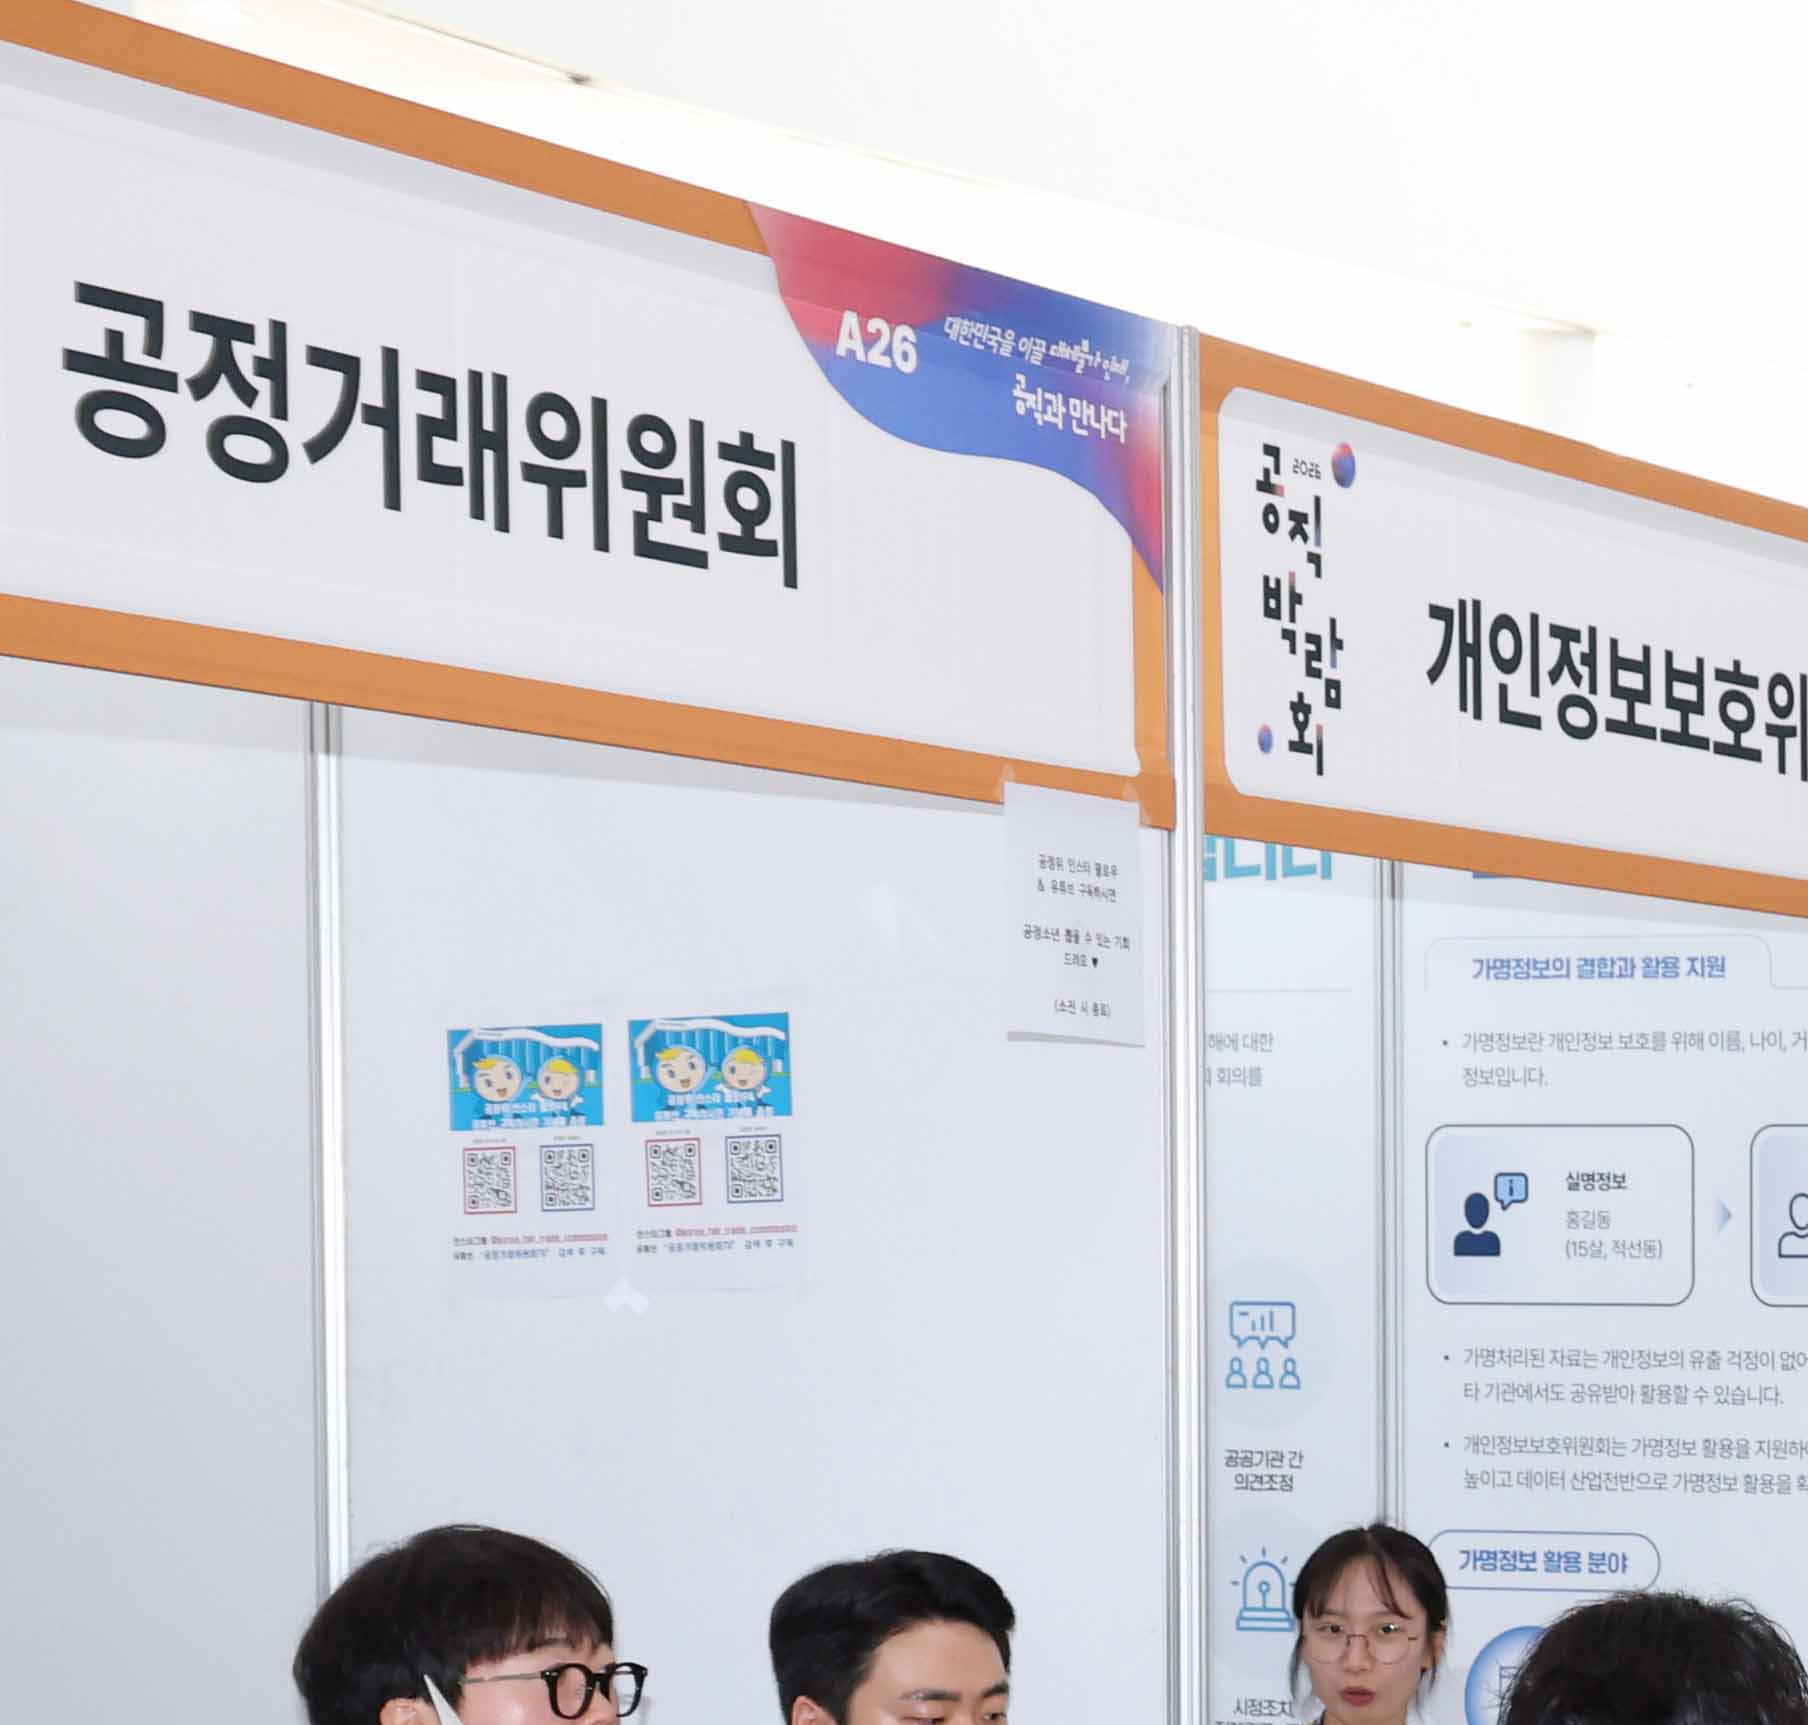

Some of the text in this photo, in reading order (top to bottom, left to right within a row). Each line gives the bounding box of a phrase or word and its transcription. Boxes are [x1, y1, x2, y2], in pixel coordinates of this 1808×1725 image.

[834, 309, 919, 374] A26
[943, 316, 1016, 358] 대한민국을
[1018, 336, 1046, 366] 이끌
[1012, 372, 1127, 444] 공직과 만나다
[62, 280, 800, 589] 공정거래위원회
[1472, 954, 1727, 981] 가명정보의 결합과 활용 지원
[1242, 1031, 1274, 1053] 대한
[1462, 1031, 1545, 1053] 가명정보란
[1549, 1031, 1614, 1053] 개인정보
[1618, 1030, 1667, 1052] 보호를
[1670, 1030, 1705, 1052] 위해
[1708, 1029, 1746, 1053] 이름,
[1749, 1029, 1787, 1053] 나이,
[1217, 1066, 1263, 1087] 회의를
[1462, 1066, 1549, 1088] 정보입니다.
[1565, 1171, 1628, 1192] 실명정보
[1565, 1210, 1611, 1230] 홍길동
[1564, 1239, 1663, 1260] (15살, 적선동)
[1463, 1347, 1545, 1369] 가명처리된
[1549, 1348, 1599, 1369] 자료는
[1602, 1349, 1685, 1370] 개인정보의
[1688, 1350, 1722, 1371] 유출
[1726, 1350, 1776, 1372] 걱정이
[1463, 1382, 1785, 1406] 타 기관에서도 공유받아 활용할 수 있습니다.
[1463, 1434, 1628, 1457] 개인정보보호위원회는
[1631, 1437, 1697, 1459] 가명정보
[1701, 1438, 1752, 1460] 활용을
[1224, 1449, 1304, 1470] 공공기관 간
[1234, 1472, 1295, 1492] 의견조정
[1463, 1469, 1512, 1490] 높이고
[1516, 1470, 1565, 1491] 데이터
[1569, 1471, 1669, 1492] 산업전반으로
[1672, 1473, 1739, 1494] 가명정보
[1743, 1473, 1792, 1495] 활용을
[1458, 1549, 1628, 1575] 가명정보 활용 분야
